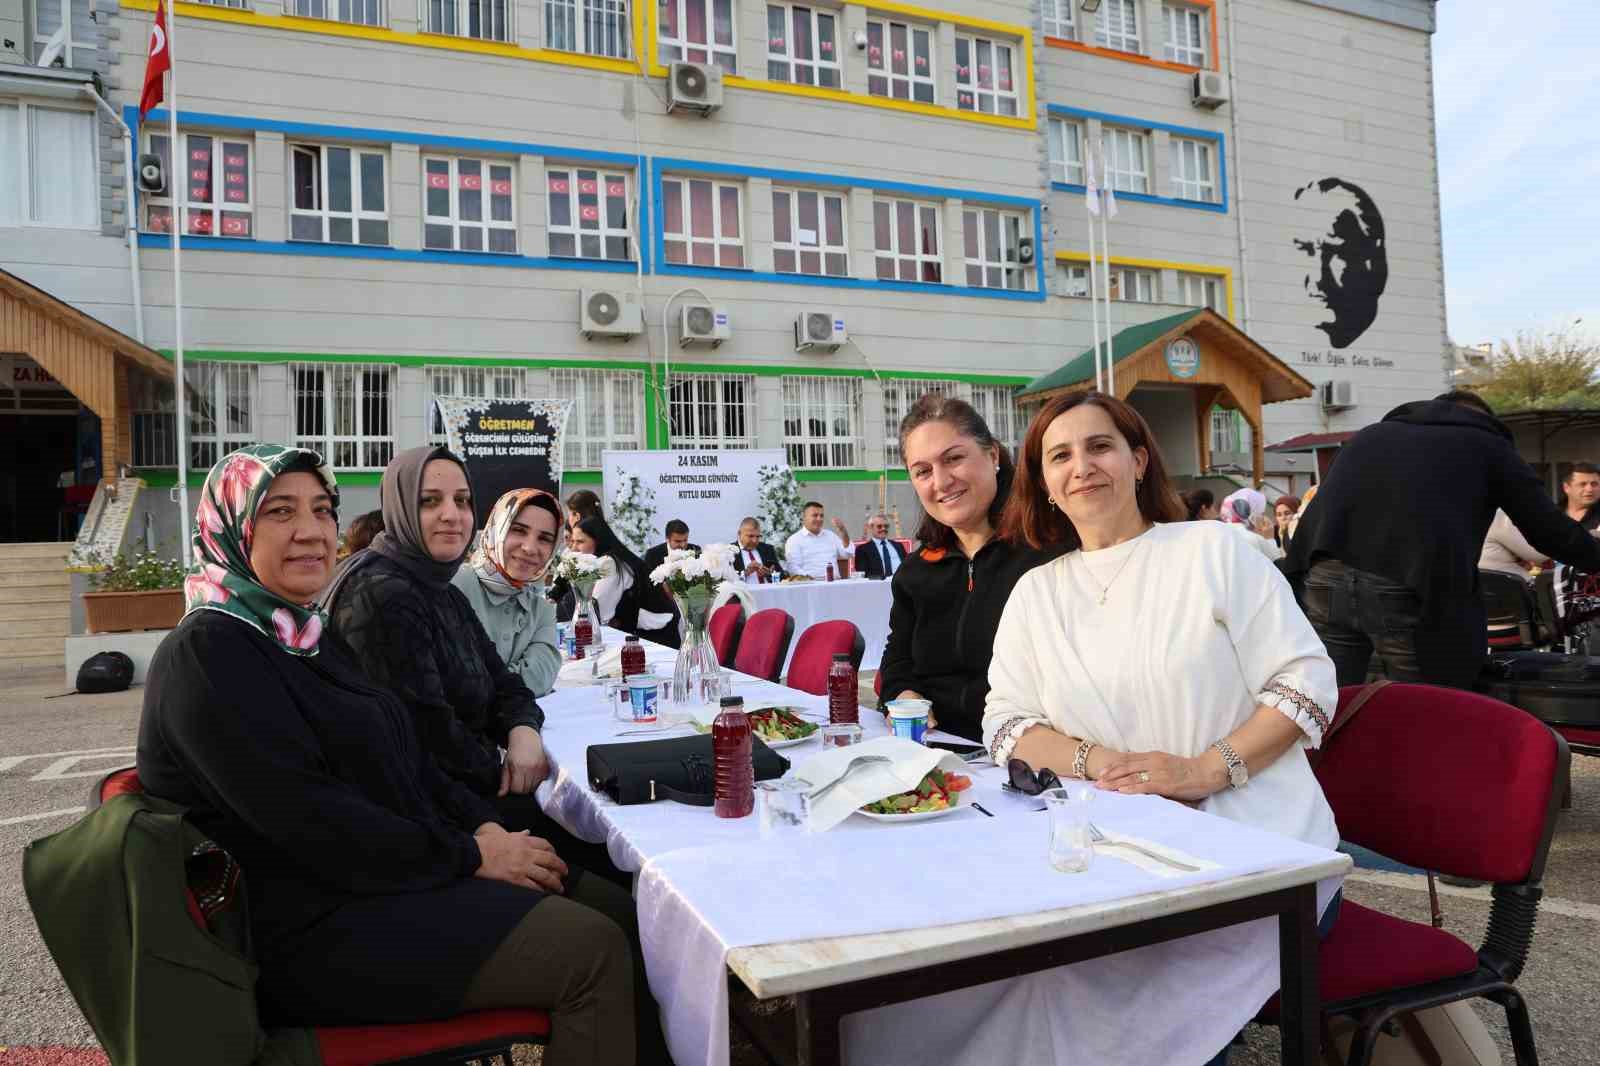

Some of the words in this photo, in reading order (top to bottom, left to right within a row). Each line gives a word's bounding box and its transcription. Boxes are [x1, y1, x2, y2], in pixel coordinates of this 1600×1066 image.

[479, 416, 535, 430] ÖĞRETMEN
[467, 444, 493, 458] DÜŞEN
[495, 445, 507, 455] İLK
[678, 456, 688, 467] 24
[690, 456, 719, 467] KASIM
[659, 472, 706, 483] ÖĞRETMENLER
[708, 472, 739, 483] GÜNÜNÜZ
[678, 490, 699, 499] KUTLU
[701, 490, 721, 499] OLSUN
